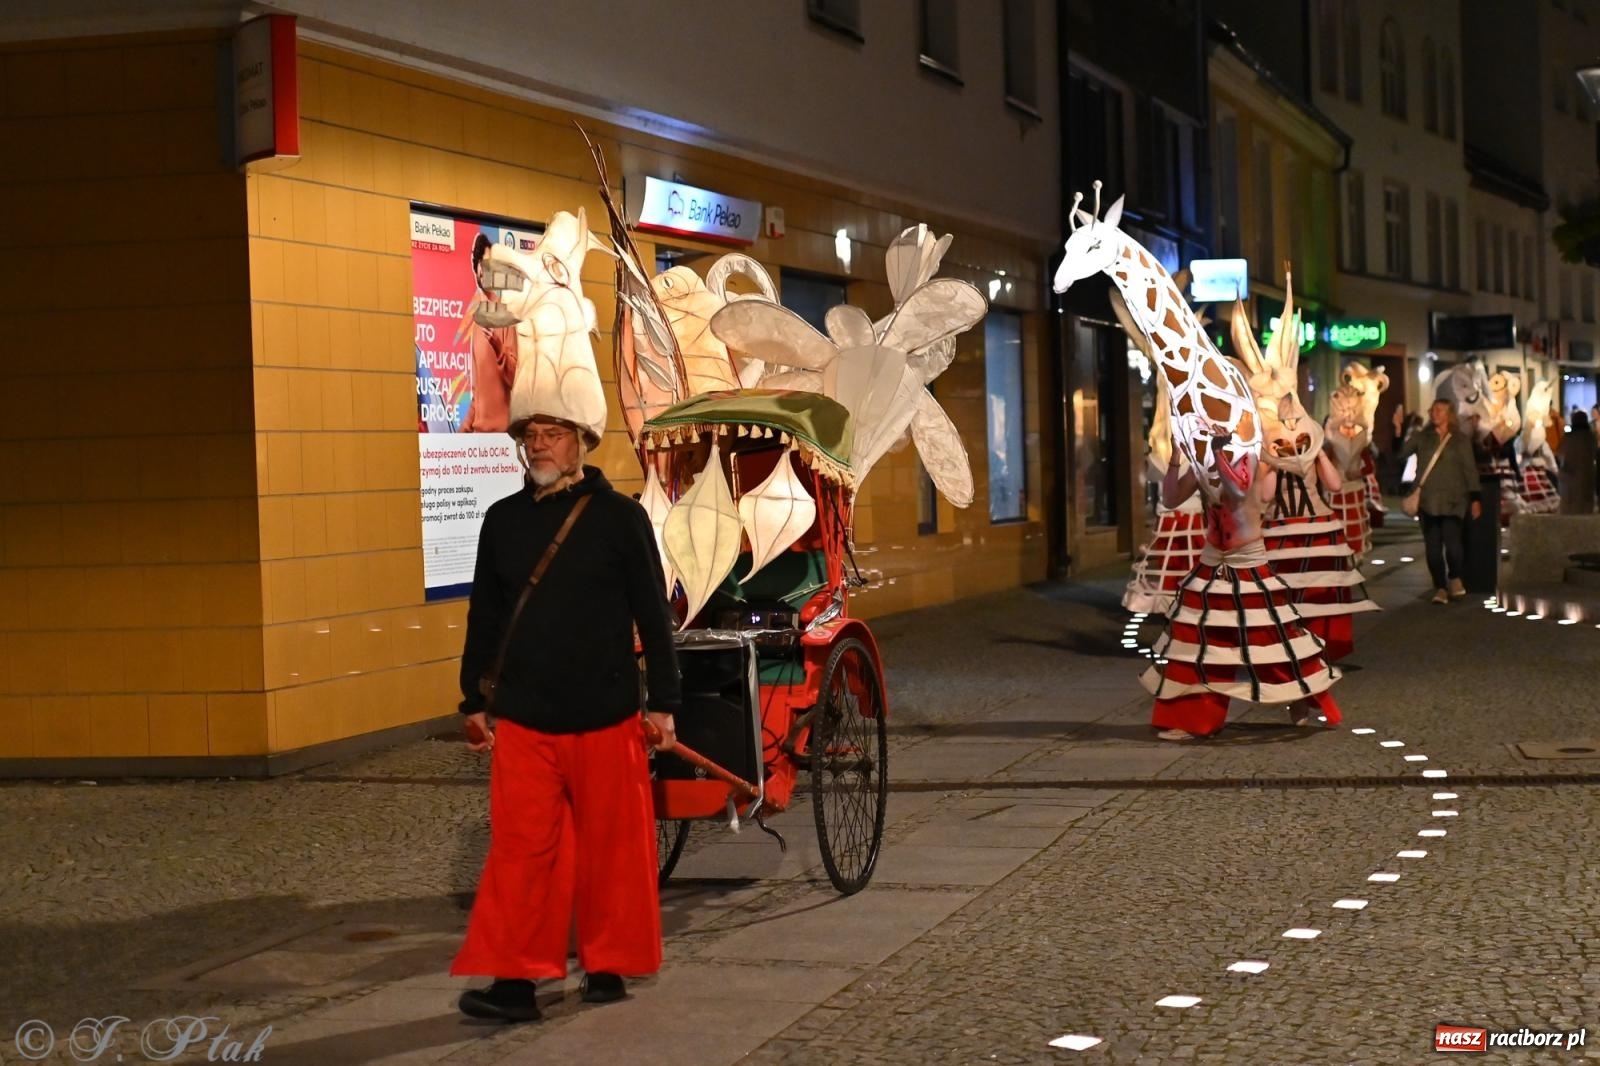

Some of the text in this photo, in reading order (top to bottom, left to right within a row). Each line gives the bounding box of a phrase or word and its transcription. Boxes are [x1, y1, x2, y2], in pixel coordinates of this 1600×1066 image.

[688, 200, 741, 229] Bank Pekao
[415, 221, 450, 238] Bank Pekao
[419, 350, 471, 375] APLIKACJI
[421, 404, 460, 427] DROGĘ
[423, 447, 510, 461] ubezpieczenie OC lub OC/AC
[442, 466, 450, 475] do
[452, 465, 462, 475] 100
[470, 465, 491, 475] zwrotu
[492, 464, 500, 474] od
[501, 463, 519, 473] banku
[438, 487, 454, 496] proces
[456, 486, 474, 495] zakupu
[436, 499, 451, 509] polisy
[457, 497, 477, 508] aplikacji
[444, 512, 458, 521] zwrot
[466, 511, 475, 520] 100
